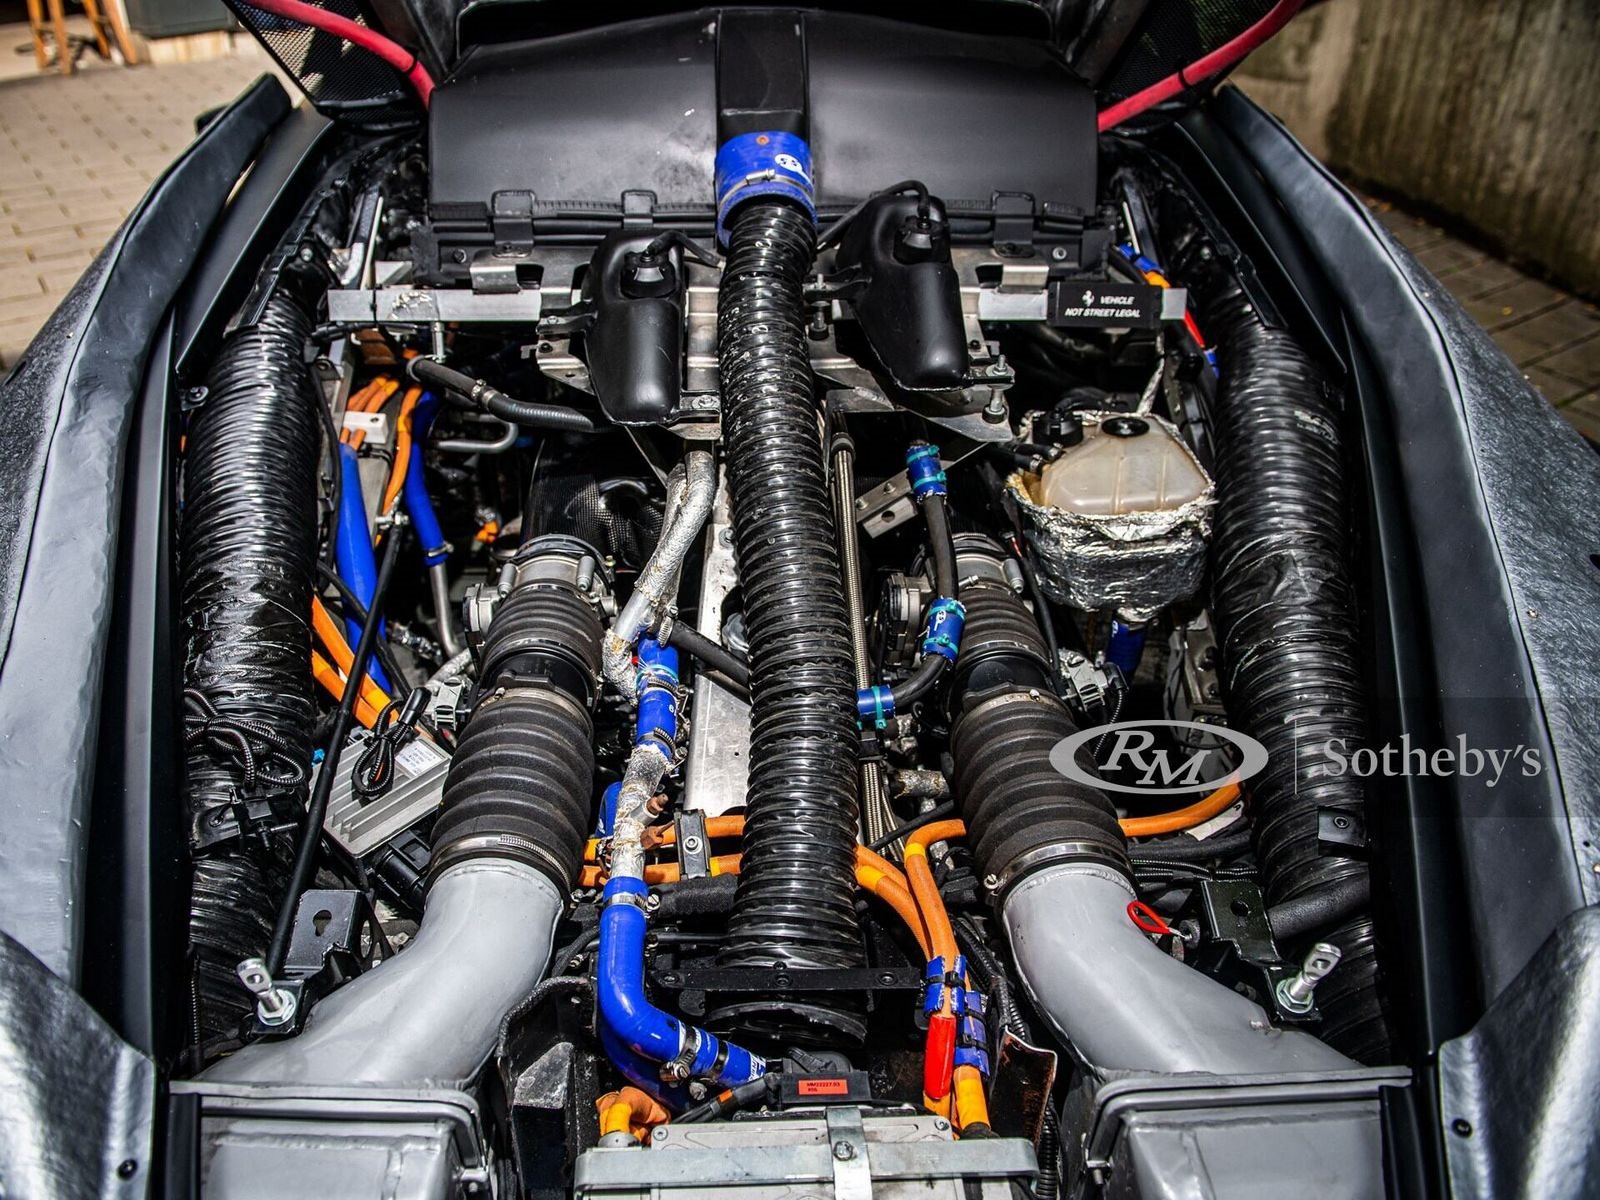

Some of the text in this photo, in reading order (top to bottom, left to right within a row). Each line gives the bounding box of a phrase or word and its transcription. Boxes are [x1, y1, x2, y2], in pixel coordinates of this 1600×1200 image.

[1100, 296, 1135, 305] VEHICLE
[1064, 307, 1141, 318] NOT STREET LEGAL
